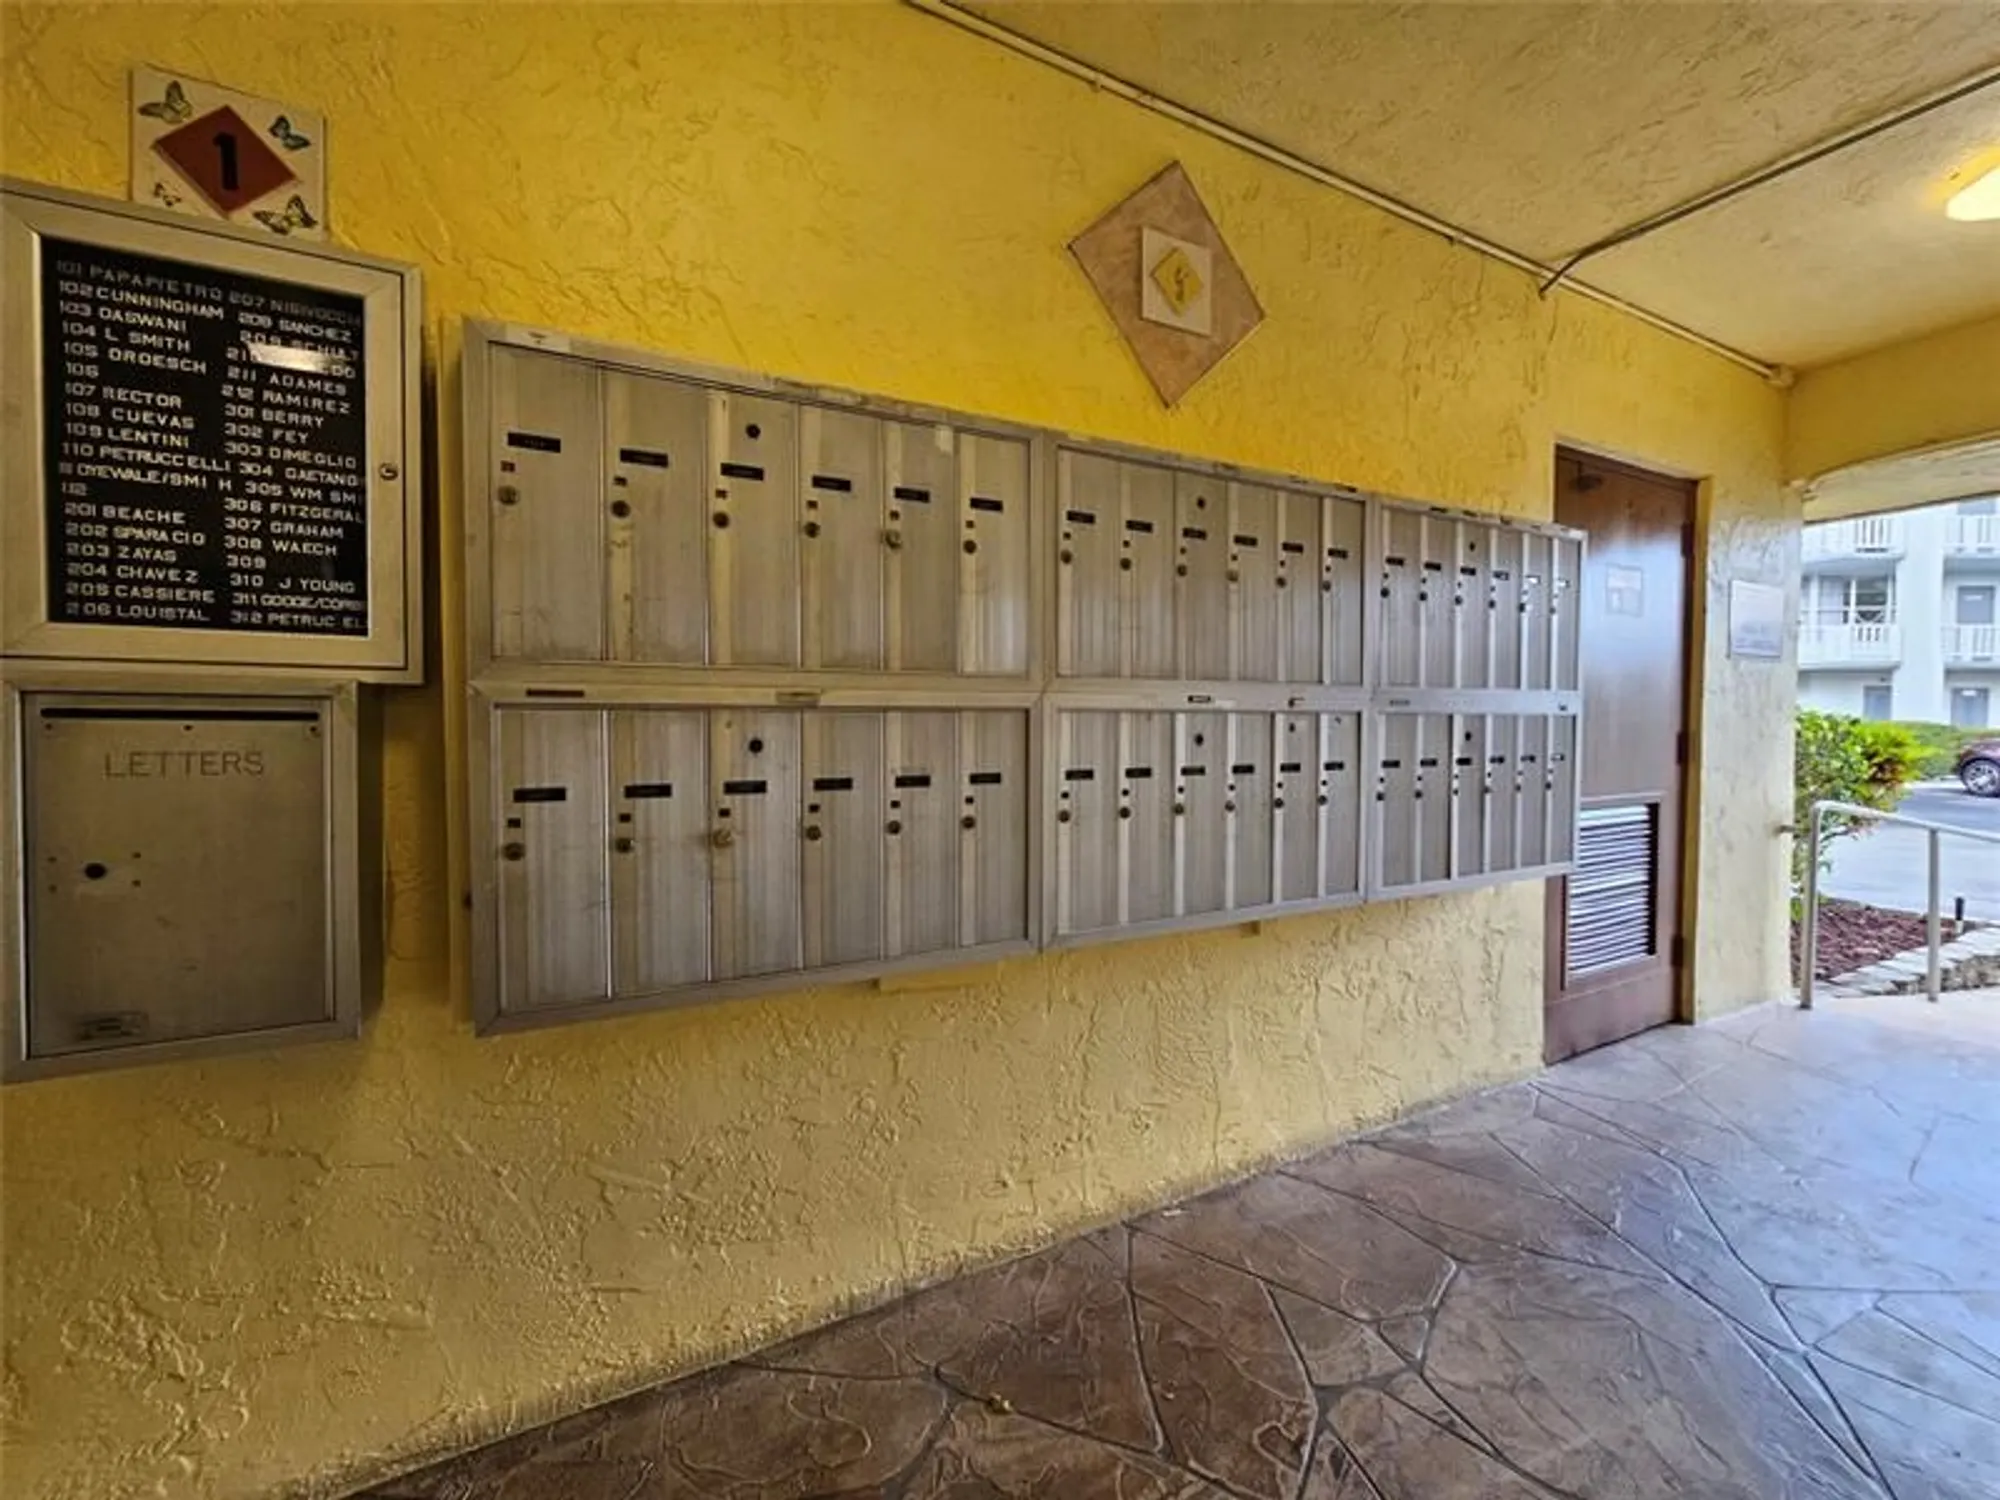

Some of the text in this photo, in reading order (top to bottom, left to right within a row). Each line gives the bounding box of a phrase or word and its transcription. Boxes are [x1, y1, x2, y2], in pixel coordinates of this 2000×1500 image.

[213, 131, 240, 191] 1
[59, 279, 225, 321] 102 CUNNINGHAM
[59, 299, 92, 317] 103
[62, 320, 191, 352] 104 L SMITH
[64, 341, 98, 358] 105
[66, 361, 99, 378] 106
[227, 365, 346, 397] 211 ADAMES
[65, 382, 182, 409] 107 RECTOR
[220, 383, 351, 415] 212 RAMIREZ
[65, 402, 195, 430] 108 CUEVAS
[224, 402, 324, 429] 301 BERRY
[65, 422, 189, 449] 109 LENTINI
[224, 422, 309, 445] 302 FEY
[62, 442, 94, 457] 110
[224, 441, 262, 457] 303
[239, 461, 274, 477] 304
[244, 480, 283, 497] 305
[288, 485, 322, 501] WM
[64, 501, 187, 524] 201 BEACHE
[65, 522, 206, 546] 202 SPARACIO
[224, 516, 344, 539] 307 GRAHAM
[65, 542, 178, 563] 203 ZAYAS
[223, 534, 262, 551] 308
[66, 562, 200, 584] 204 CHAVEZ
[225, 554, 266, 570] 309
[66, 582, 216, 604] 205 CASSIERE
[229, 572, 356, 594] 310 J YOUNG
[232, 592, 258, 606] 311
[66, 602, 211, 622] 206 LOUISTAL
[230, 610, 263, 624] 312
[105, 750, 266, 779] LETTERS
